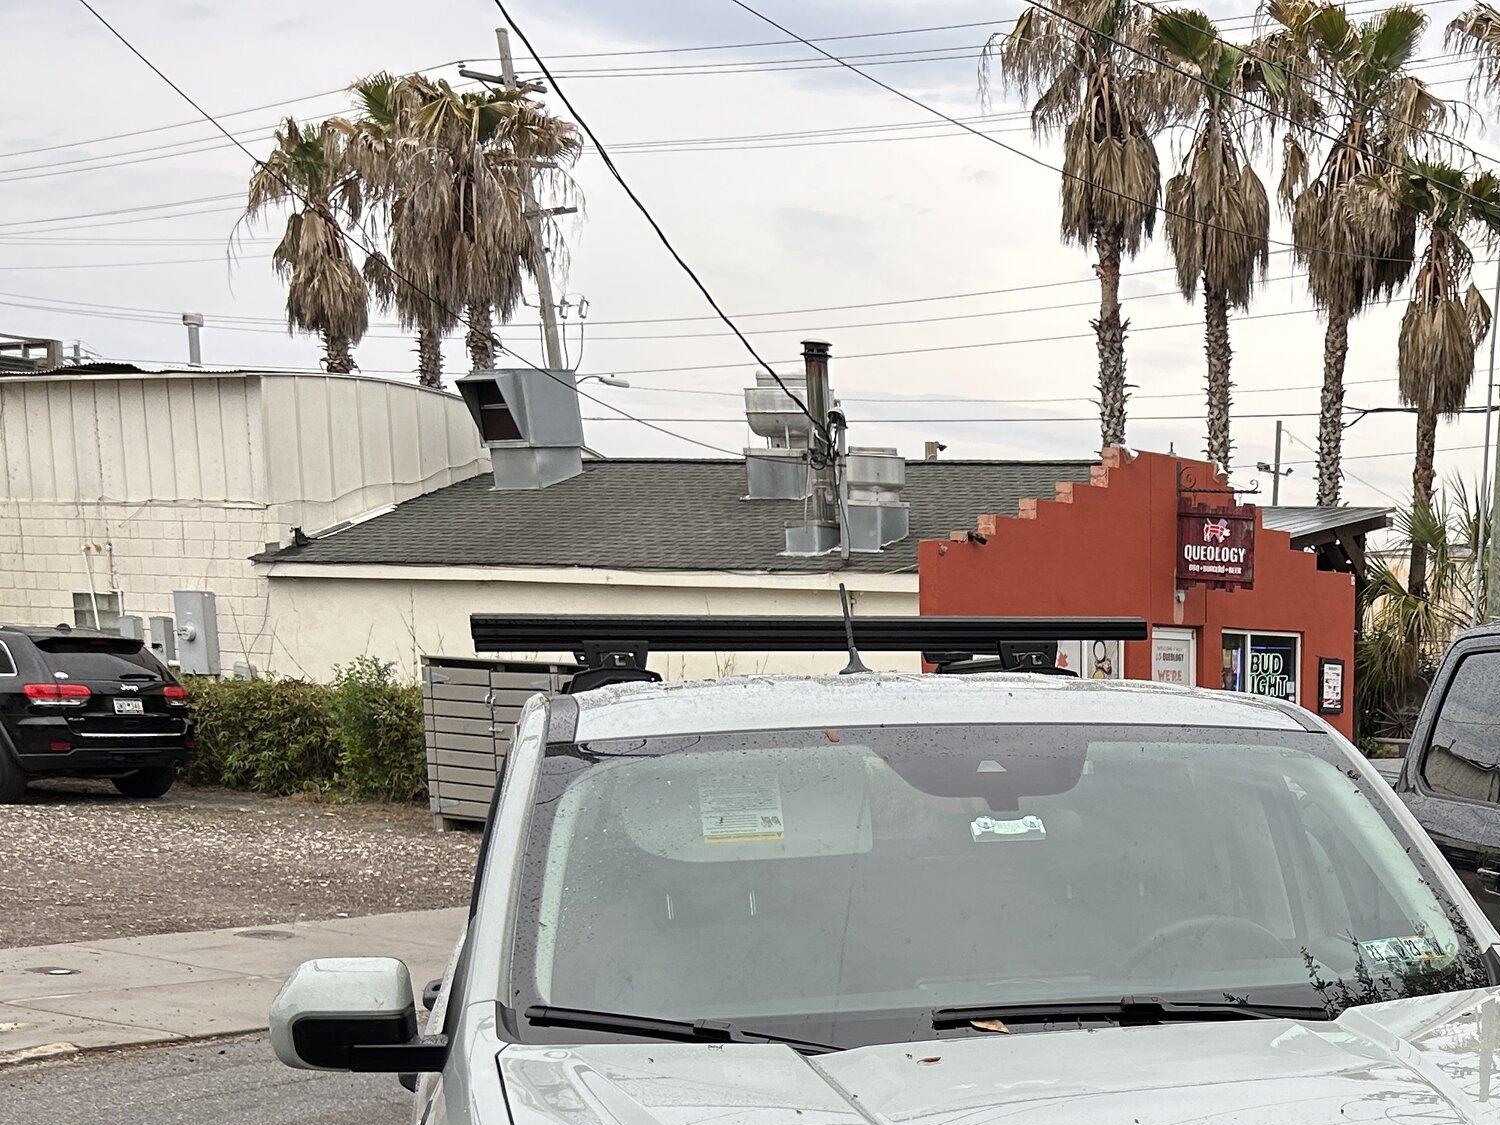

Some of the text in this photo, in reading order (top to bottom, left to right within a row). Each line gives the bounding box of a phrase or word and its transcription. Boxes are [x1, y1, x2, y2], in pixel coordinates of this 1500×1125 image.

[1184, 544, 1246, 563] QUEOLOGY
[1250, 653, 1283, 676] BUD
[120, 683, 139, 693] Jeep
[1250, 675, 1288, 697] IGHT
